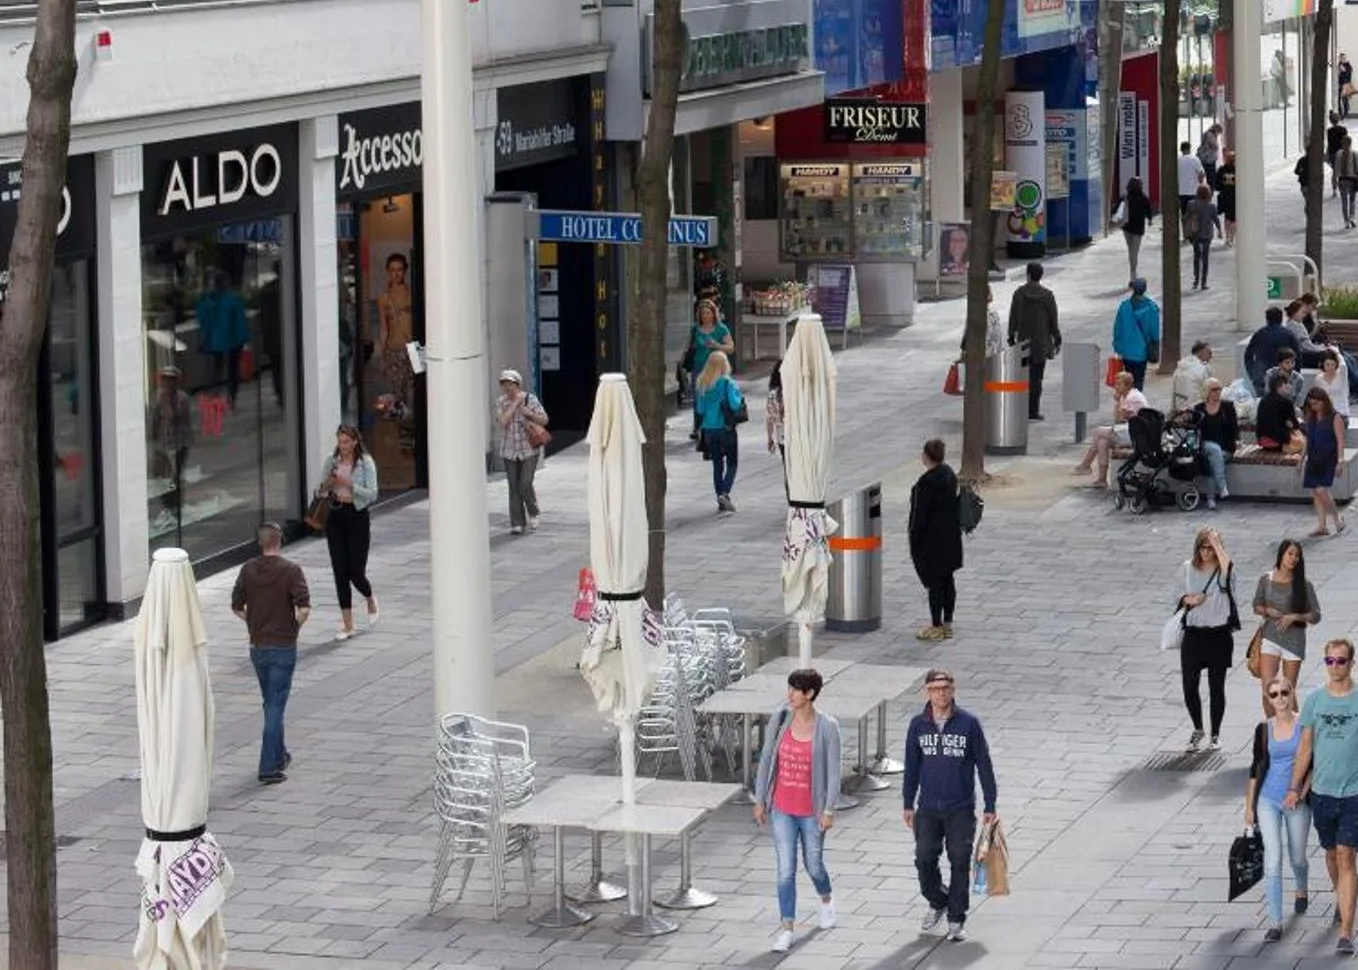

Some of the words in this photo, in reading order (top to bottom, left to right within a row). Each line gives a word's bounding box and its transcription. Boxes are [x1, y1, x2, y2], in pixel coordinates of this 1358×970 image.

[829, 106, 921, 128] FRISEUR
[159, 142, 282, 217] ALDO
[340, 122, 423, 190] Accesso
[561, 215, 617, 240] HOTEL
[622, 216, 707, 244] COINUS
